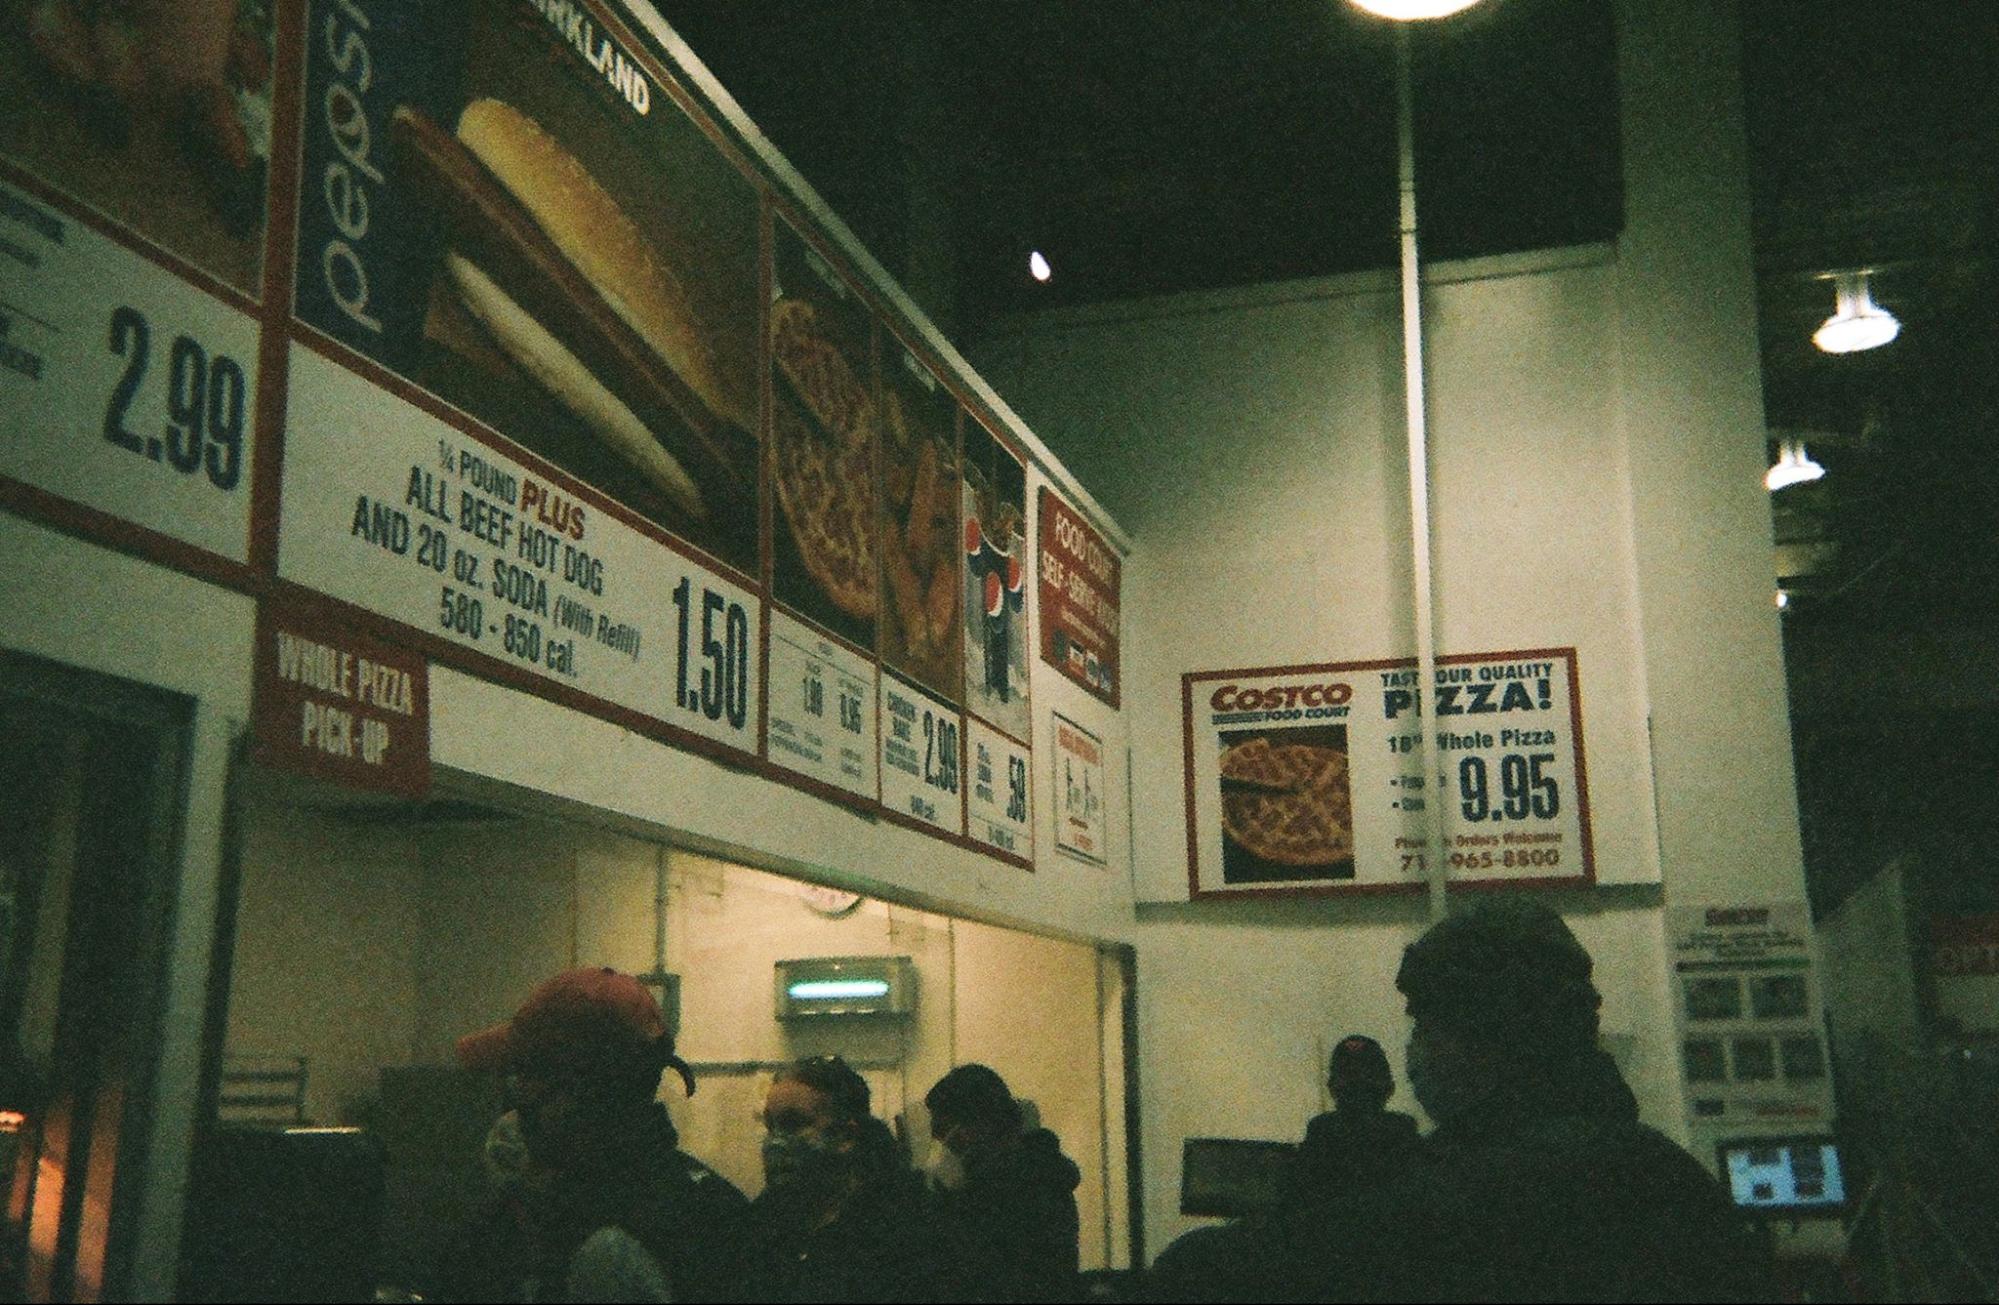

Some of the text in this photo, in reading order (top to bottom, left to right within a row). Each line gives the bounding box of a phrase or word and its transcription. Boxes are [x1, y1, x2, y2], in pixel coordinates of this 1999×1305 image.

[530, 0, 650, 116] RKLAND
[103, 304, 246, 491] 2.99
[405, 464, 604, 597] ALL BEEF HOT DOG
[459, 449, 518, 506] POUND
[519, 478, 586, 541] PLUS
[352, 494, 411, 556] AND
[416, 522, 448, 574] 20
[492, 557, 549, 619] SODA
[277, 630, 414, 717] WHOLE PIZZA
[439, 584, 484, 641] 580
[503, 612, 542, 664] 850
[546, 638, 578, 678] cal.
[672, 575, 748, 731] 1.50
[1210, 683, 1353, 712] COSTCO
[1266, 705, 1350, 722] FOOD COURT
[1380, 670, 1421, 688] TAST
[1478, 662, 1552, 681] QUALITY
[302, 700, 390, 766] PICK-UP
[922, 709, 959, 795] 2.99
[1501, 729, 1556, 748] Pizza
[1459, 752, 1560, 823] 9.95
[1456, 833, 1499, 848] Orders
[1503, 830, 1563, 846] Welcome
